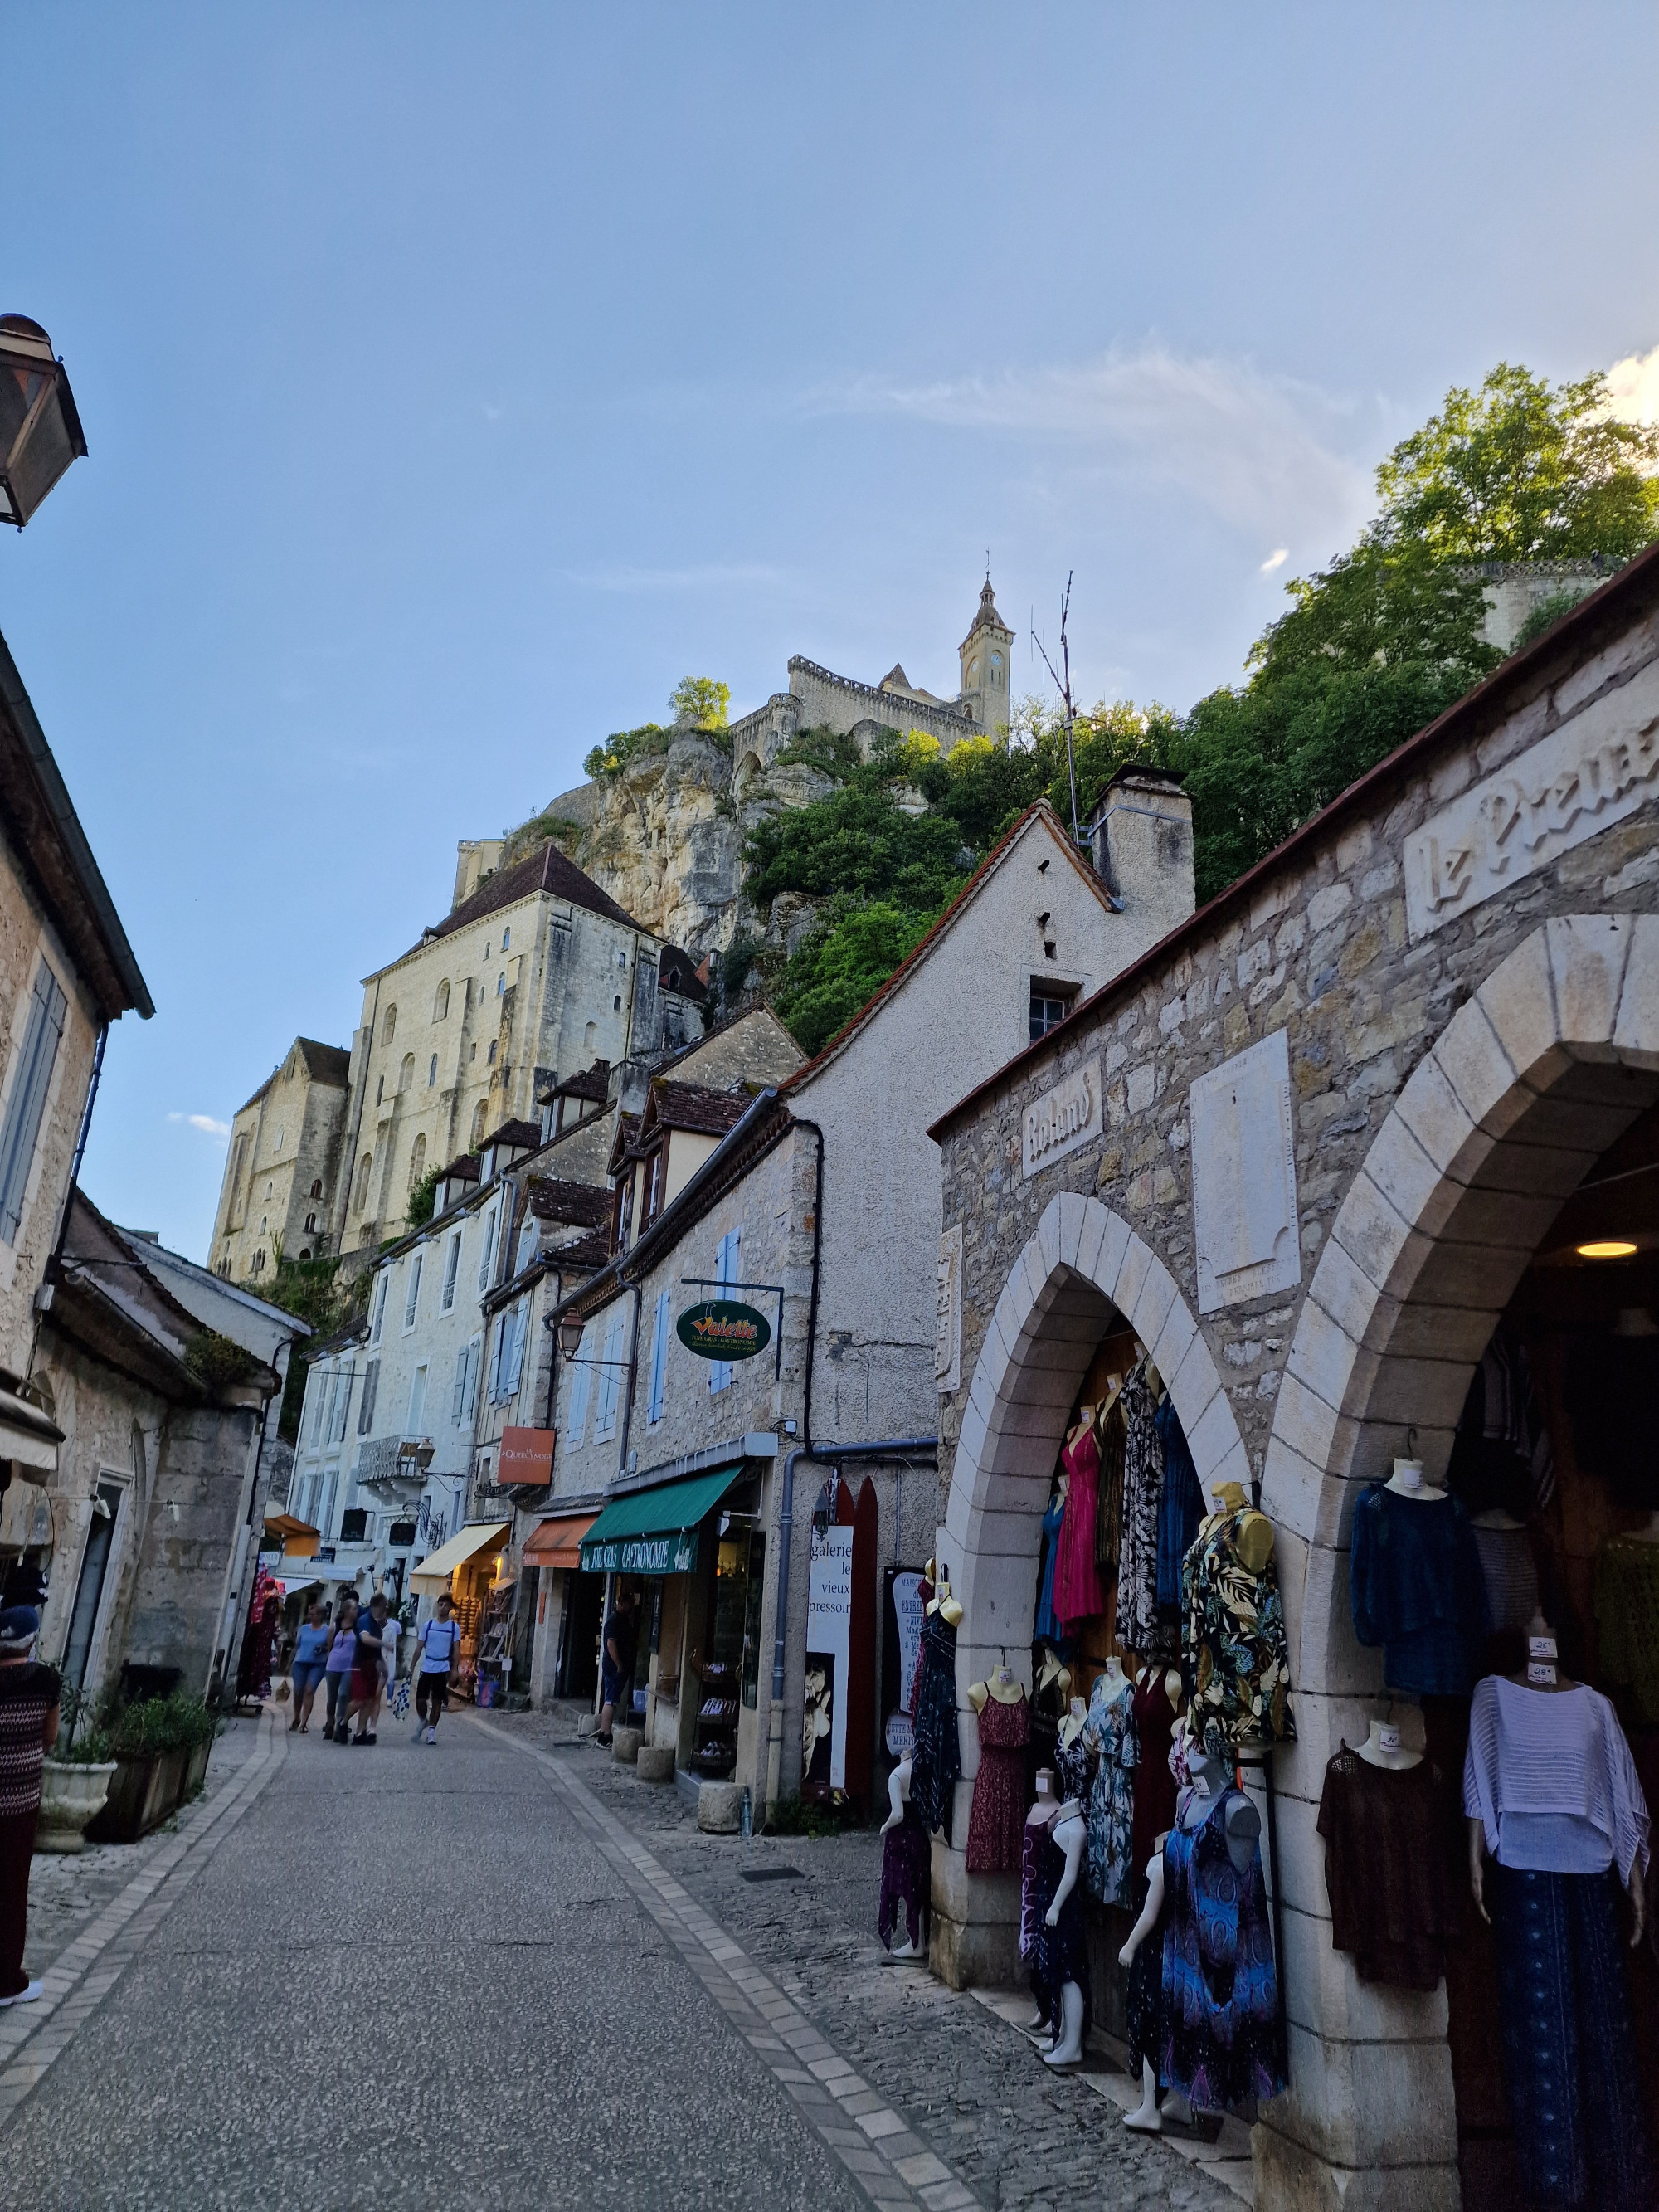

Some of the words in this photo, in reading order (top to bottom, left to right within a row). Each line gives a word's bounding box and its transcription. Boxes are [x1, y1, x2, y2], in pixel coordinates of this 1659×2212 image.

[690, 1313, 758, 1341] Valette
[720, 1337, 757, 1347] GASTRONOMIE
[603, 1544, 618, 1568] GRAS
[621, 1540, 670, 1569] GASTRONOMIE
[810, 1541, 852, 1562] galerie
[841, 1562, 851, 1575] le
[821, 1581, 850, 1594] vieux
[808, 1601, 851, 1616] pressoir
